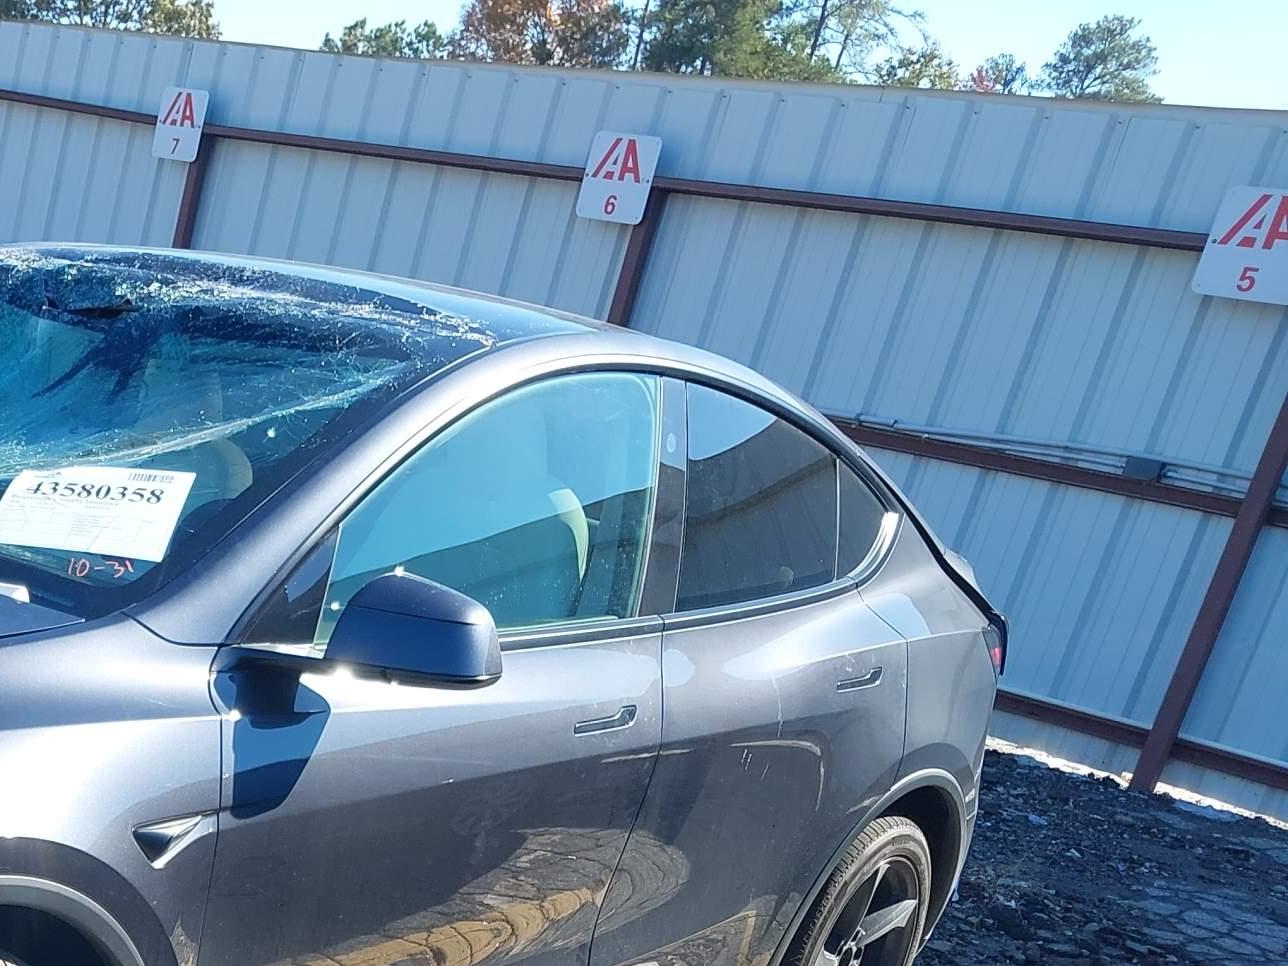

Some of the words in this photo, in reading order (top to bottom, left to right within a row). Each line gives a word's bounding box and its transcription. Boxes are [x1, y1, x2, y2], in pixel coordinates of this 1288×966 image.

[170, 137, 180, 155] 7
[603, 194, 618, 215] 6
[1236, 266, 1260, 293] 5
[25, 480, 166, 505] 43580358
[67, 557, 135, 579] 10-31
